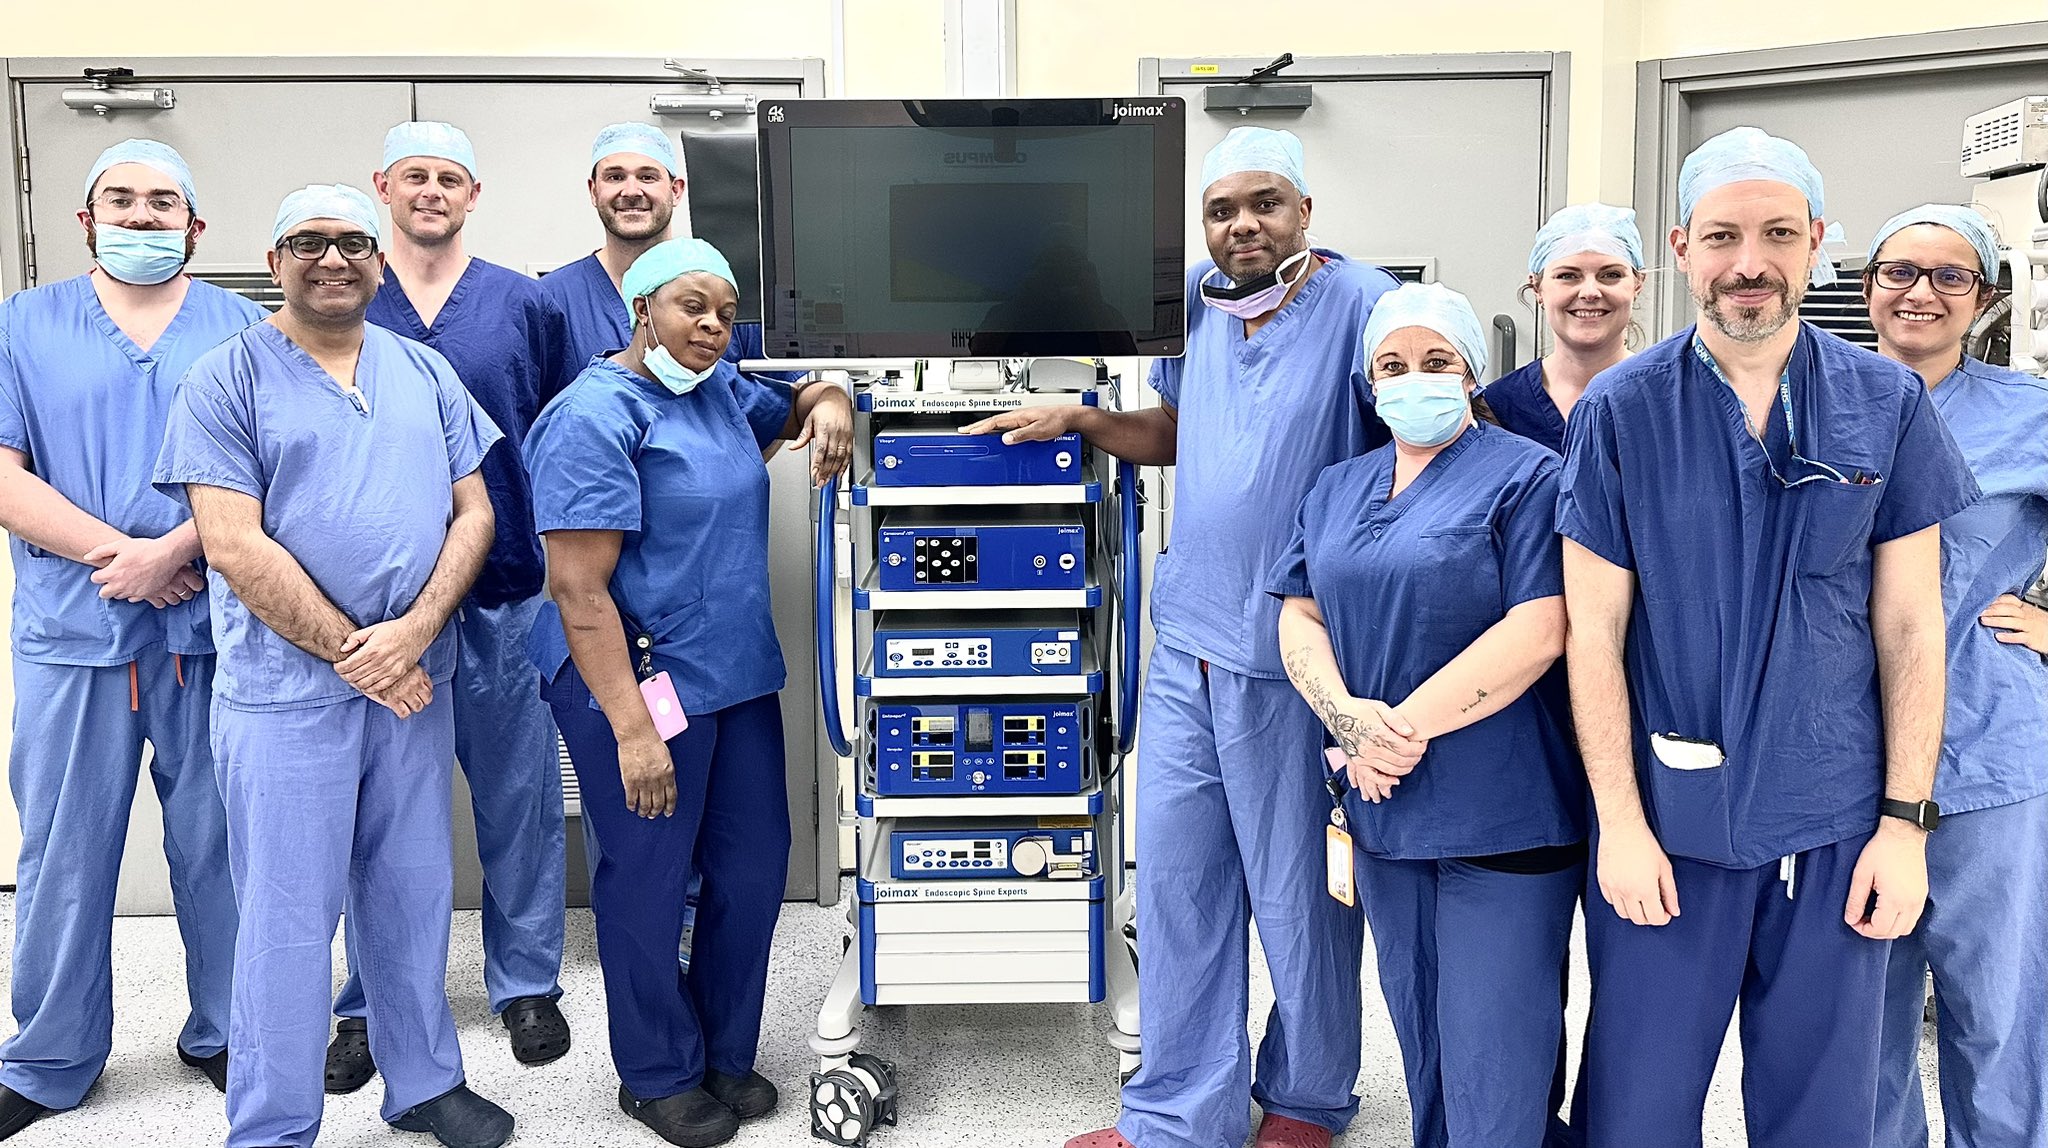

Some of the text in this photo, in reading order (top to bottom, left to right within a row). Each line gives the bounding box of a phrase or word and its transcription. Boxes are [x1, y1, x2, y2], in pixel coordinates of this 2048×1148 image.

[768, 105, 784, 117] 4K
[1112, 103, 1164, 120] joimax
[1697, 344, 1710, 363] NHS
[1780, 383, 1789, 403] NHS
[873, 397, 1022, 410] joimax Endoscopic Spine Experts
[875, 887, 1028, 900] joimax Endoscopic Spine Experts
